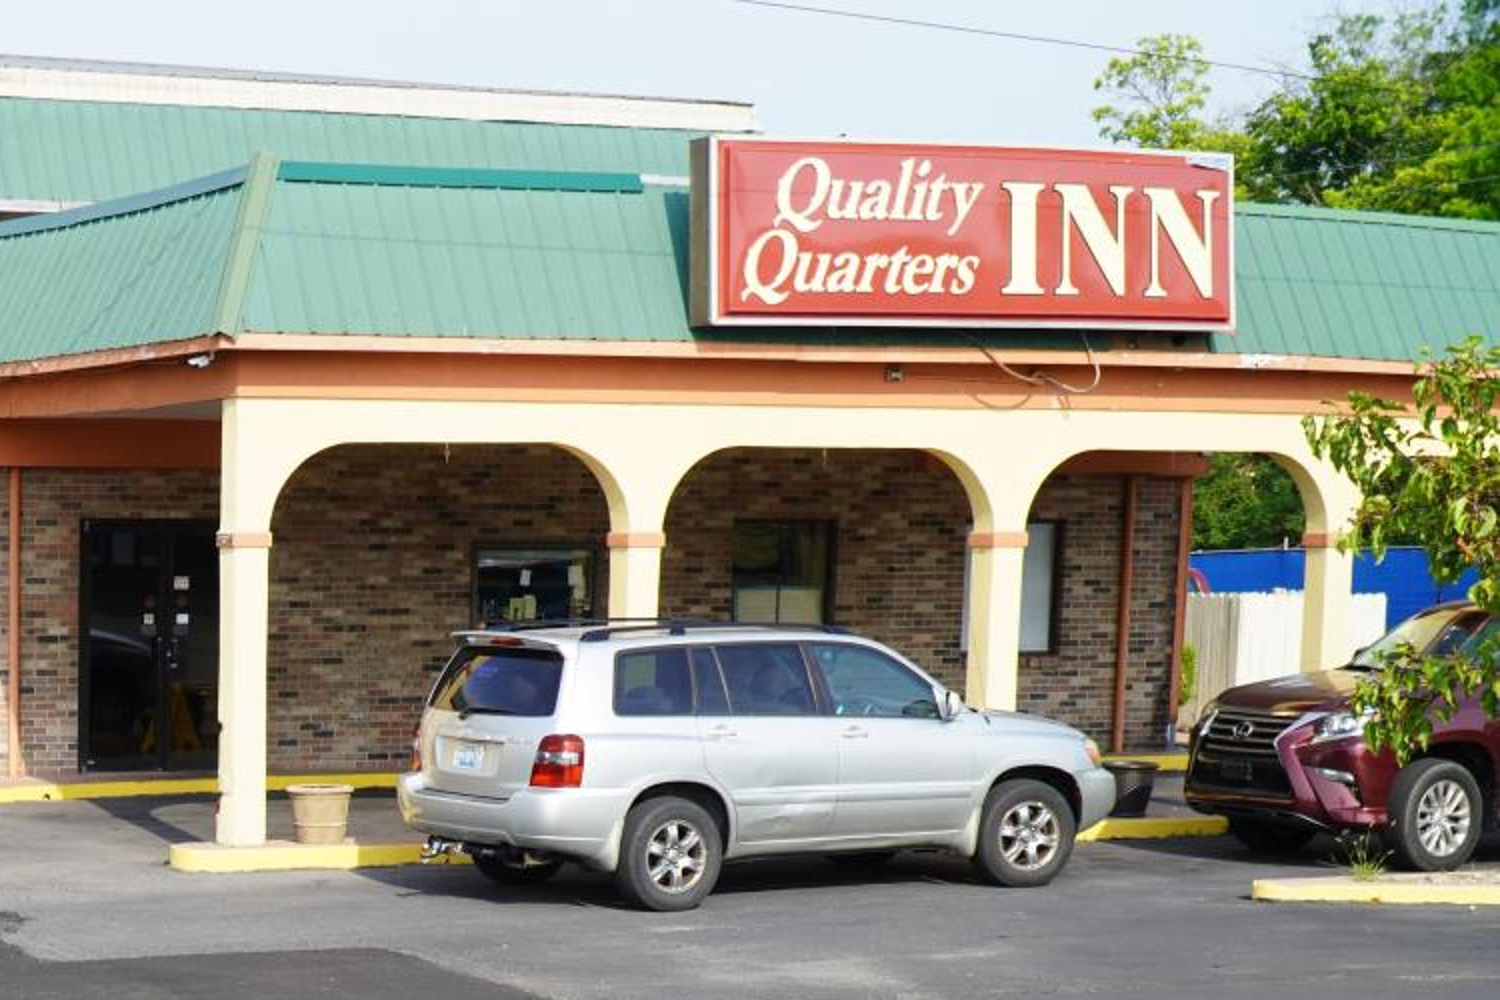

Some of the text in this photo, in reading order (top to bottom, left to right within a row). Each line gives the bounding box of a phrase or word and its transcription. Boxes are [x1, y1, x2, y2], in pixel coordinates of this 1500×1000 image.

[773, 157, 984, 236] Quality
[741, 228, 980, 305] Quarters
[1000, 181, 1221, 299] INN
